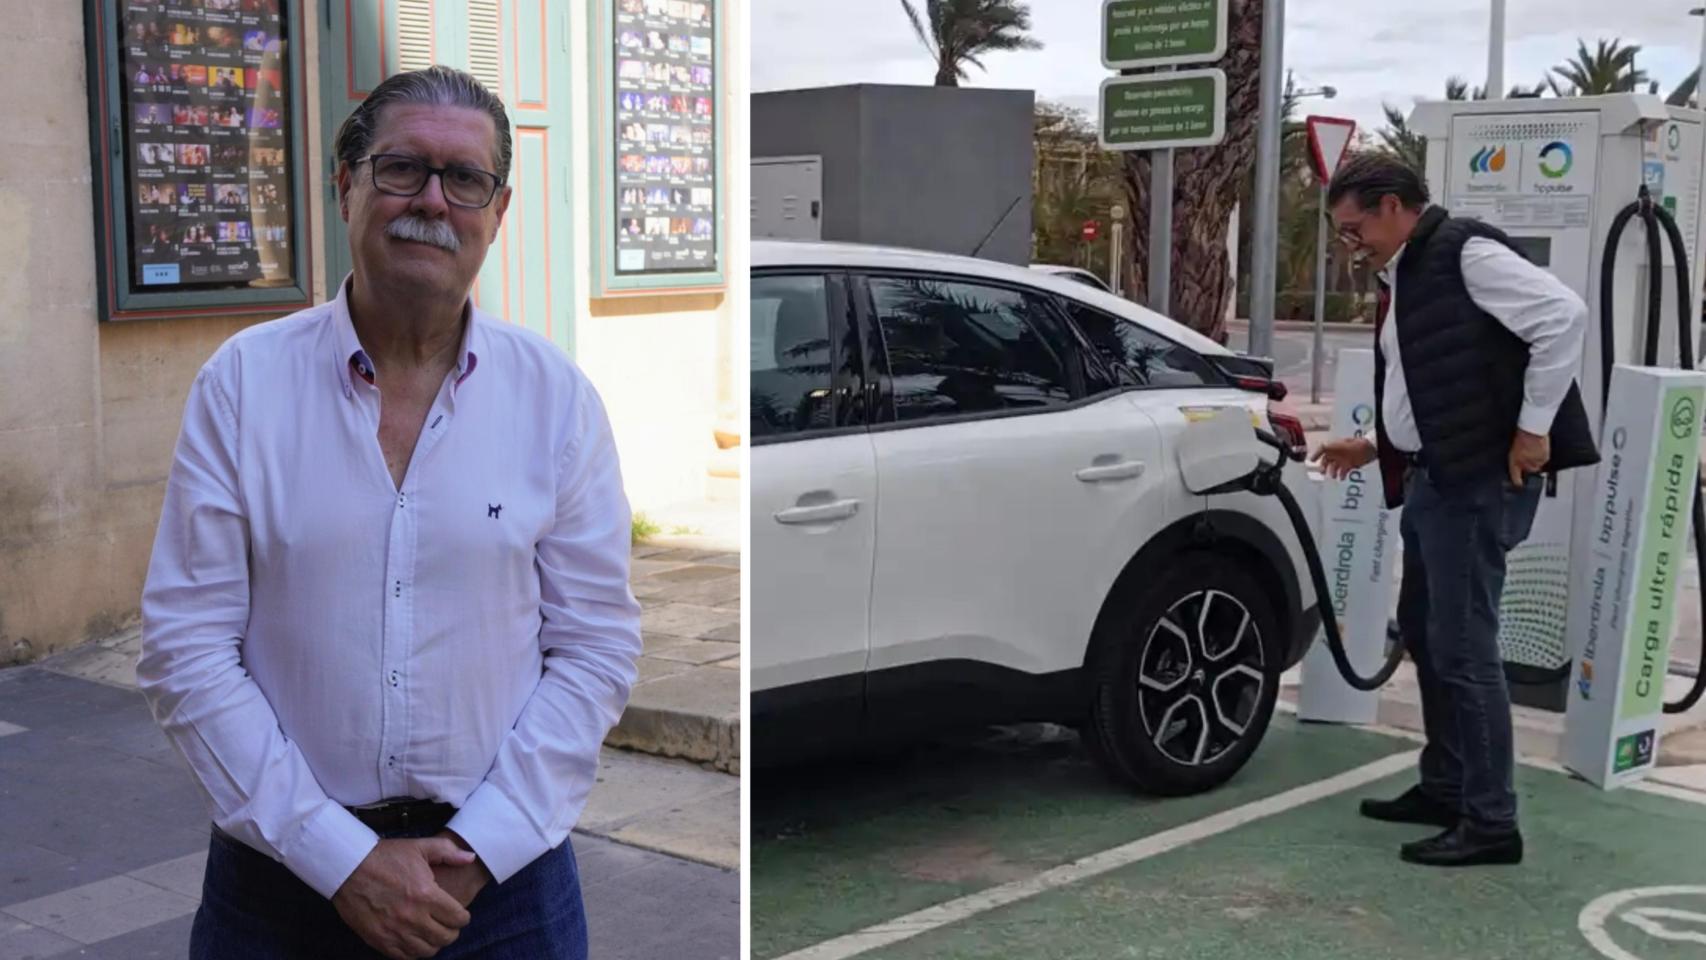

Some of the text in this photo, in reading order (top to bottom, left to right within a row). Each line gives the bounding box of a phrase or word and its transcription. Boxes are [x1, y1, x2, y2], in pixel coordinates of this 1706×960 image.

[1598, 454, 1622, 543] bppulse
[1635, 454, 1685, 698] Carga ultra rápida
